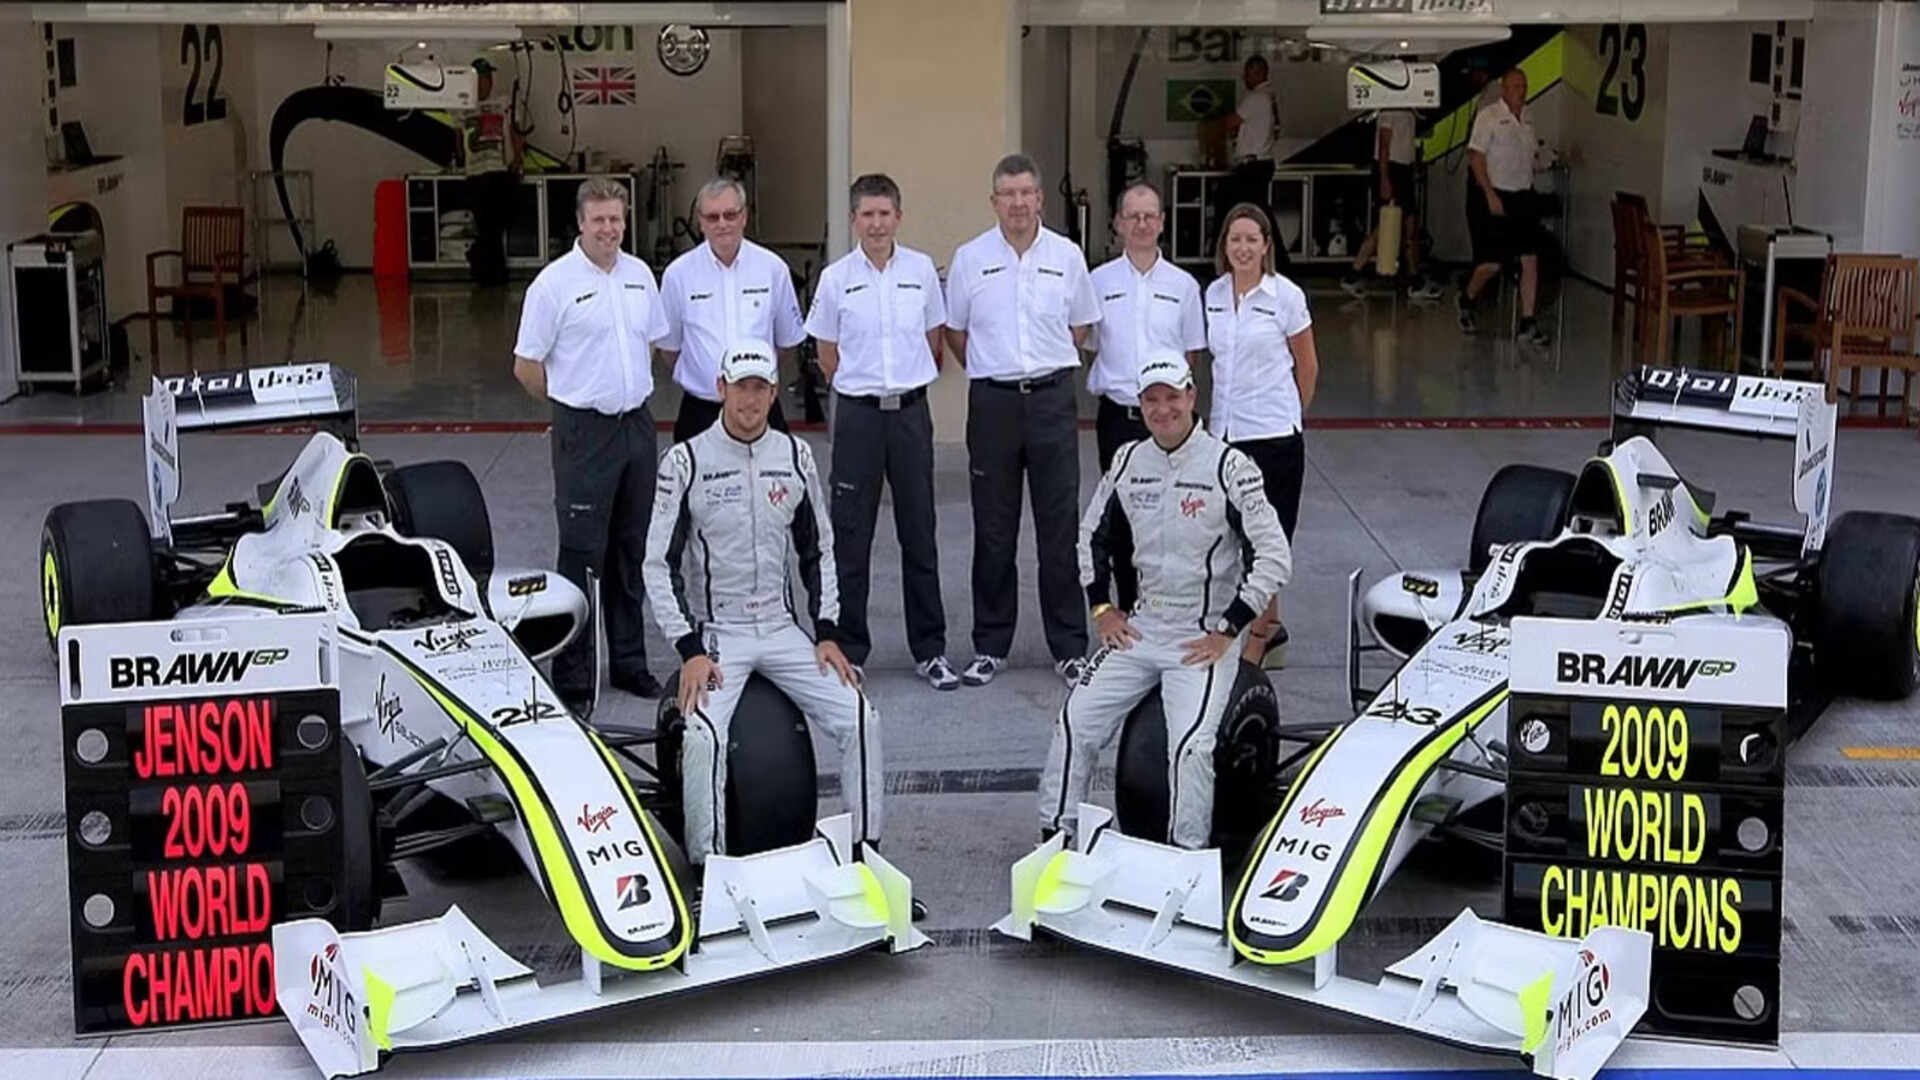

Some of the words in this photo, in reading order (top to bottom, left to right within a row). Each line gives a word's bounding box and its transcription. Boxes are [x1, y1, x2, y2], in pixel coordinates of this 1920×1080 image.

[181, 24, 226, 126] 22
[1596, 24, 1647, 121] 23
[110, 650, 252, 688] BRAWN
[252, 648, 289, 665] GP
[1557, 652, 1700, 689] BRAWN
[1698, 660, 1736, 677] GP
[135, 699, 273, 779] JENSON
[1600, 704, 1689, 781] 2009
[162, 781, 251, 859] 2009
[577, 803, 618, 833] Virgin
[1275, 836, 1332, 861] MIG
[1300, 798, 1346, 828] Virgin
[1584, 788, 1706, 865] WORLD
[586, 840, 644, 866] MIG
[149, 863, 272, 940] WORLD
[1541, 865, 1742, 953] CHAMPIONS
[315, 959, 356, 1034] MIG
[1558, 965, 1604, 1039] MIG
